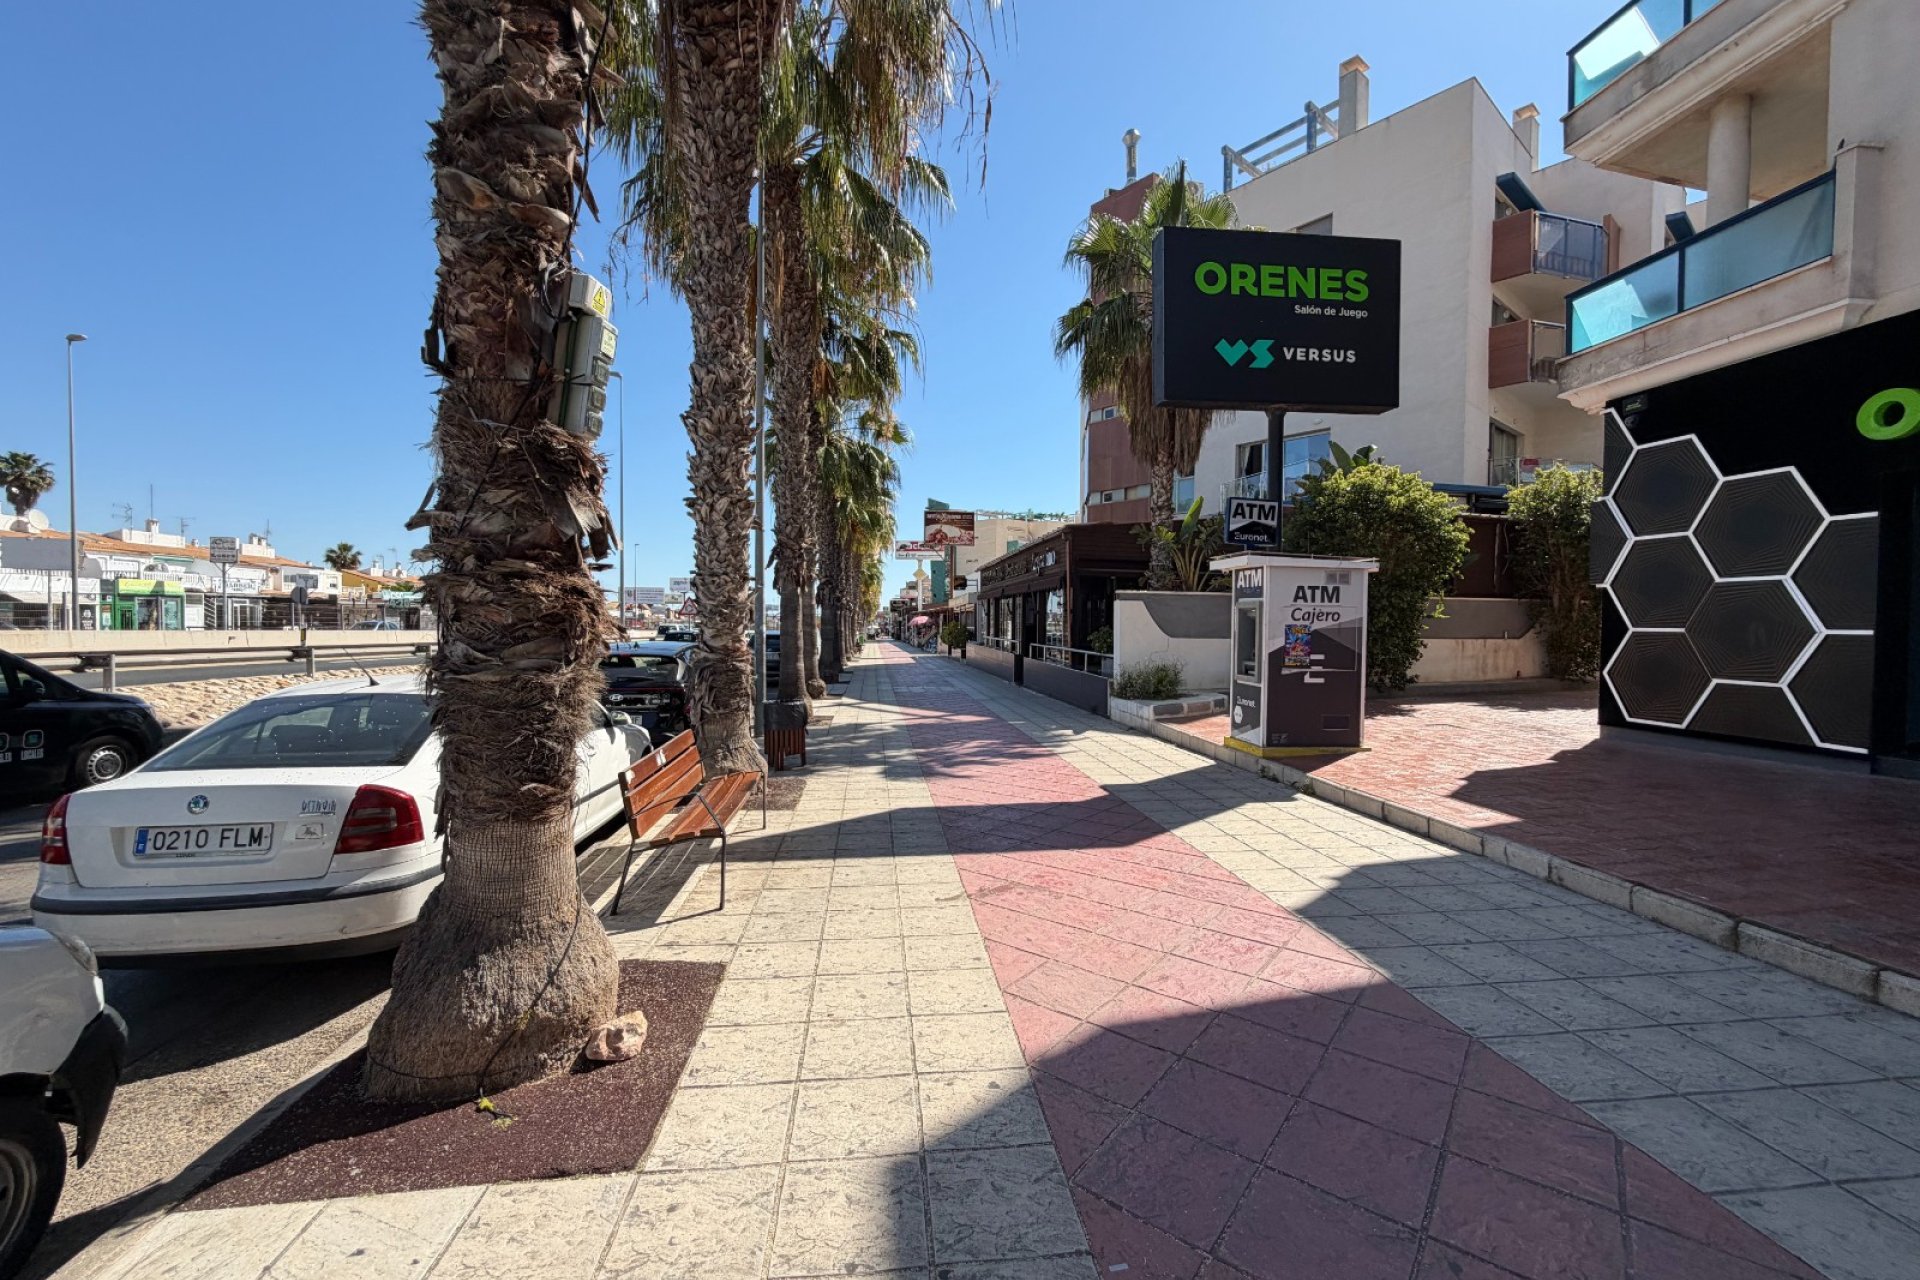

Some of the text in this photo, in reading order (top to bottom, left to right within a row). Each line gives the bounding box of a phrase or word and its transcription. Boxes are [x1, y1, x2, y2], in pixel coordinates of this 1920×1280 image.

[1195, 261, 1369, 302] ORENES
[1294, 304, 1368, 319] Salón de Juego
[1282, 347, 1356, 363] VERSUS
[1232, 502, 1276, 521] ATM
[1237, 568, 1262, 588] ATM
[1292, 585, 1340, 603] ATM
[1290, 607, 1341, 625] Cajero
[153, 826, 264, 850] 0210 FLM
